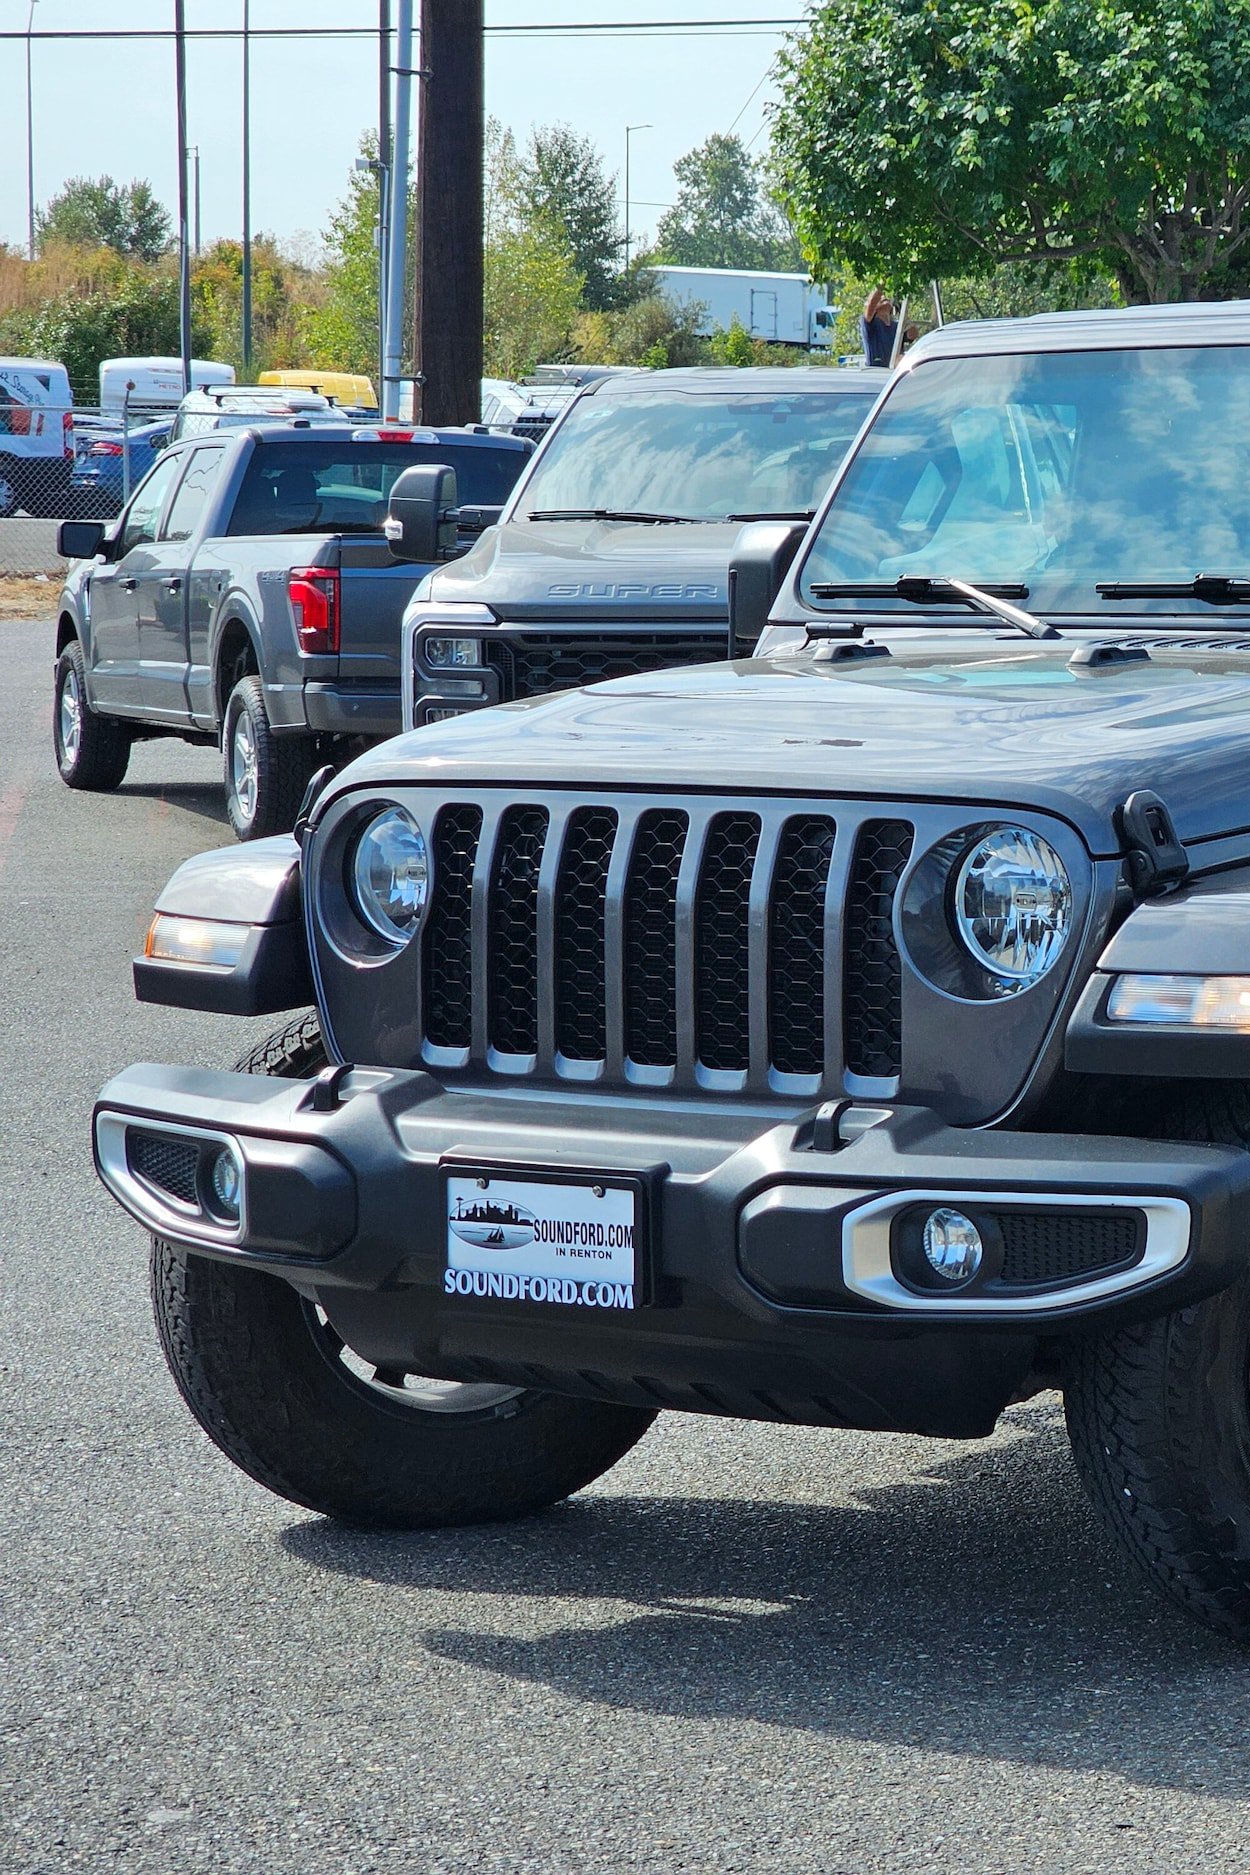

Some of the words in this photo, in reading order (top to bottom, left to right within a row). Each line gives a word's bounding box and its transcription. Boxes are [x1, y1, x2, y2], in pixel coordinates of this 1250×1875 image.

[547, 583, 718, 599] SUPER
[534, 1219, 635, 1248] SOUNDFORD.COM
[556, 1247, 566, 1257] IN
[570, 1248, 613, 1260] RENTON
[444, 1268, 635, 1309] SOUNDFORD.COM
